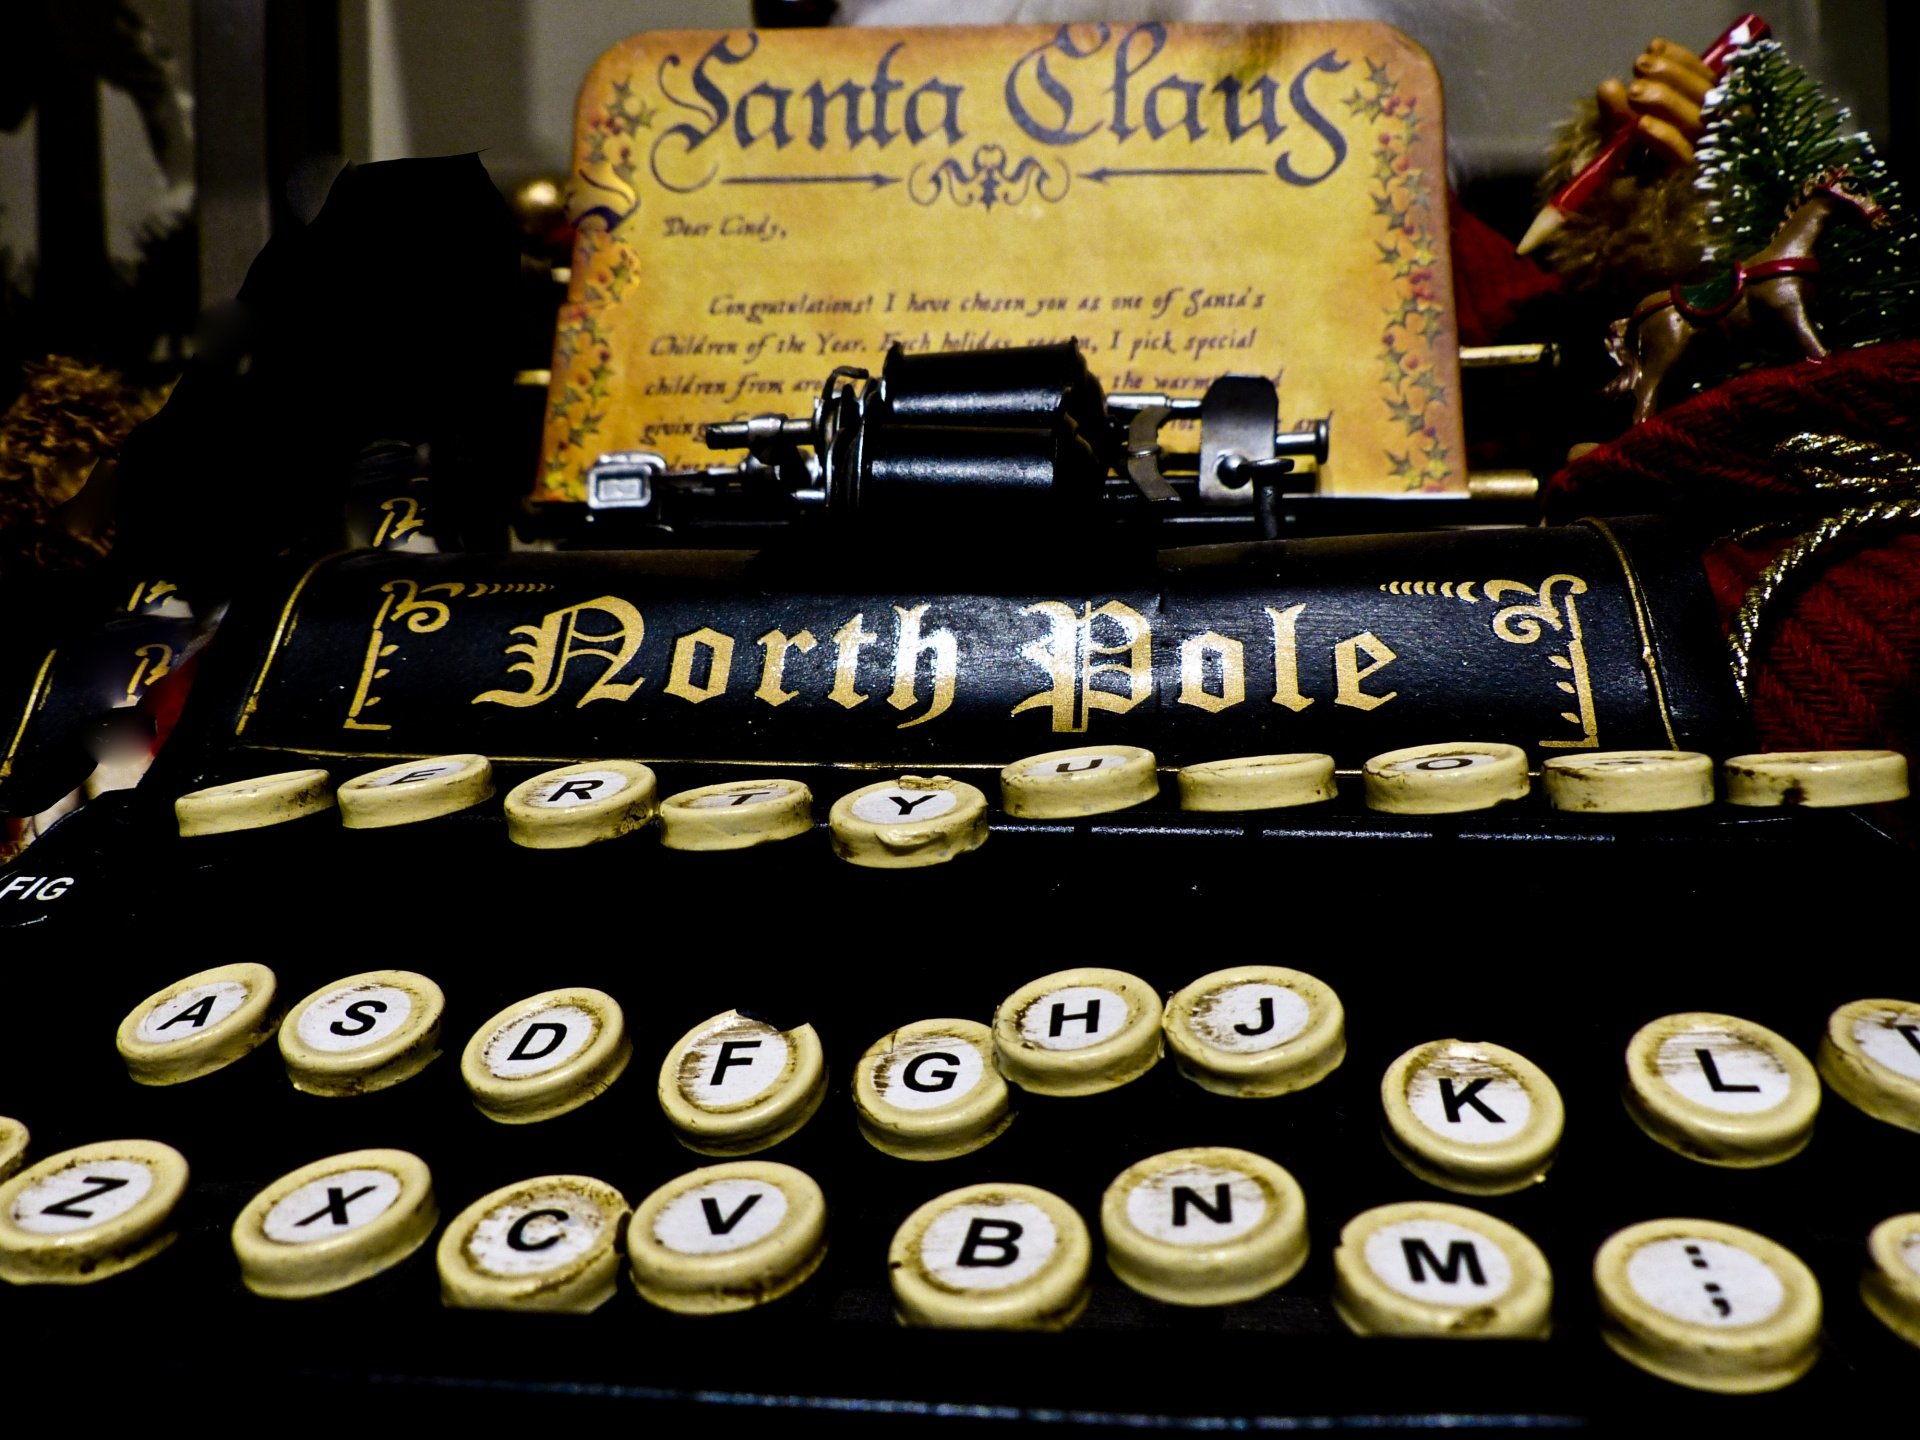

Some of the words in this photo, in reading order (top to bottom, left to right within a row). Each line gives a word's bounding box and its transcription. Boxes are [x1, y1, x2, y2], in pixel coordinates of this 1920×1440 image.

[650, 31, 966, 193] Santa
[1004, 21, 1351, 187] Claus
[662, 215, 711, 238] Dear
[719, 212, 787, 242] Cindy,
[709, 292, 874, 324] Congratulations!
[884, 293, 896, 313] I
[905, 292, 951, 313] have
[960, 291, 1026, 313] chosen
[1025, 297, 1068, 318] you
[1078, 298, 1103, 312] as
[1112, 296, 1144, 311] one
[1151, 287, 1184, 320] of
[1184, 287, 1267, 319] Santa's
[649, 333, 738, 357] Children
[741, 332, 778, 364] of
[776, 335, 806, 353] the
[814, 330, 867, 354] Year.
[880, 331, 931, 352] Ech
[1110, 330, 1122, 350] I
[1130, 330, 1178, 361] pick
[1184, 328, 1258, 361] special
[644, 373, 726, 397] children
[724, 371, 784, 404] from
[1112, 370, 1144, 391] the
[470, 594, 960, 730] North
[1009, 599, 1399, 734] Pole
[387, 766, 447, 785] E
[1055, 757, 1105, 774] U
[546, 779, 606, 802] R
[727, 791, 772, 806] T
[888, 794, 937, 816] Y
[0, 876, 75, 901] FIG
[156, 995, 219, 1031] A
[329, 999, 388, 1037] S
[1047, 999, 1102, 1038] H
[1233, 997, 1276, 1037] J
[506, 1022, 568, 1062] D
[709, 1040, 761, 1086] F
[901, 1052, 961, 1094] G
[1694, 1048, 1761, 1093] L
[1438, 1077, 1507, 1124] K
[40, 1176, 130, 1219] Z
[292, 1185, 378, 1226] X
[699, 1193, 762, 1236] V
[1171, 1183, 1231, 1227] N
[506, 1208, 570, 1253] C
[955, 1218, 1025, 1268] B
[1400, 1237, 1488, 1287] M
